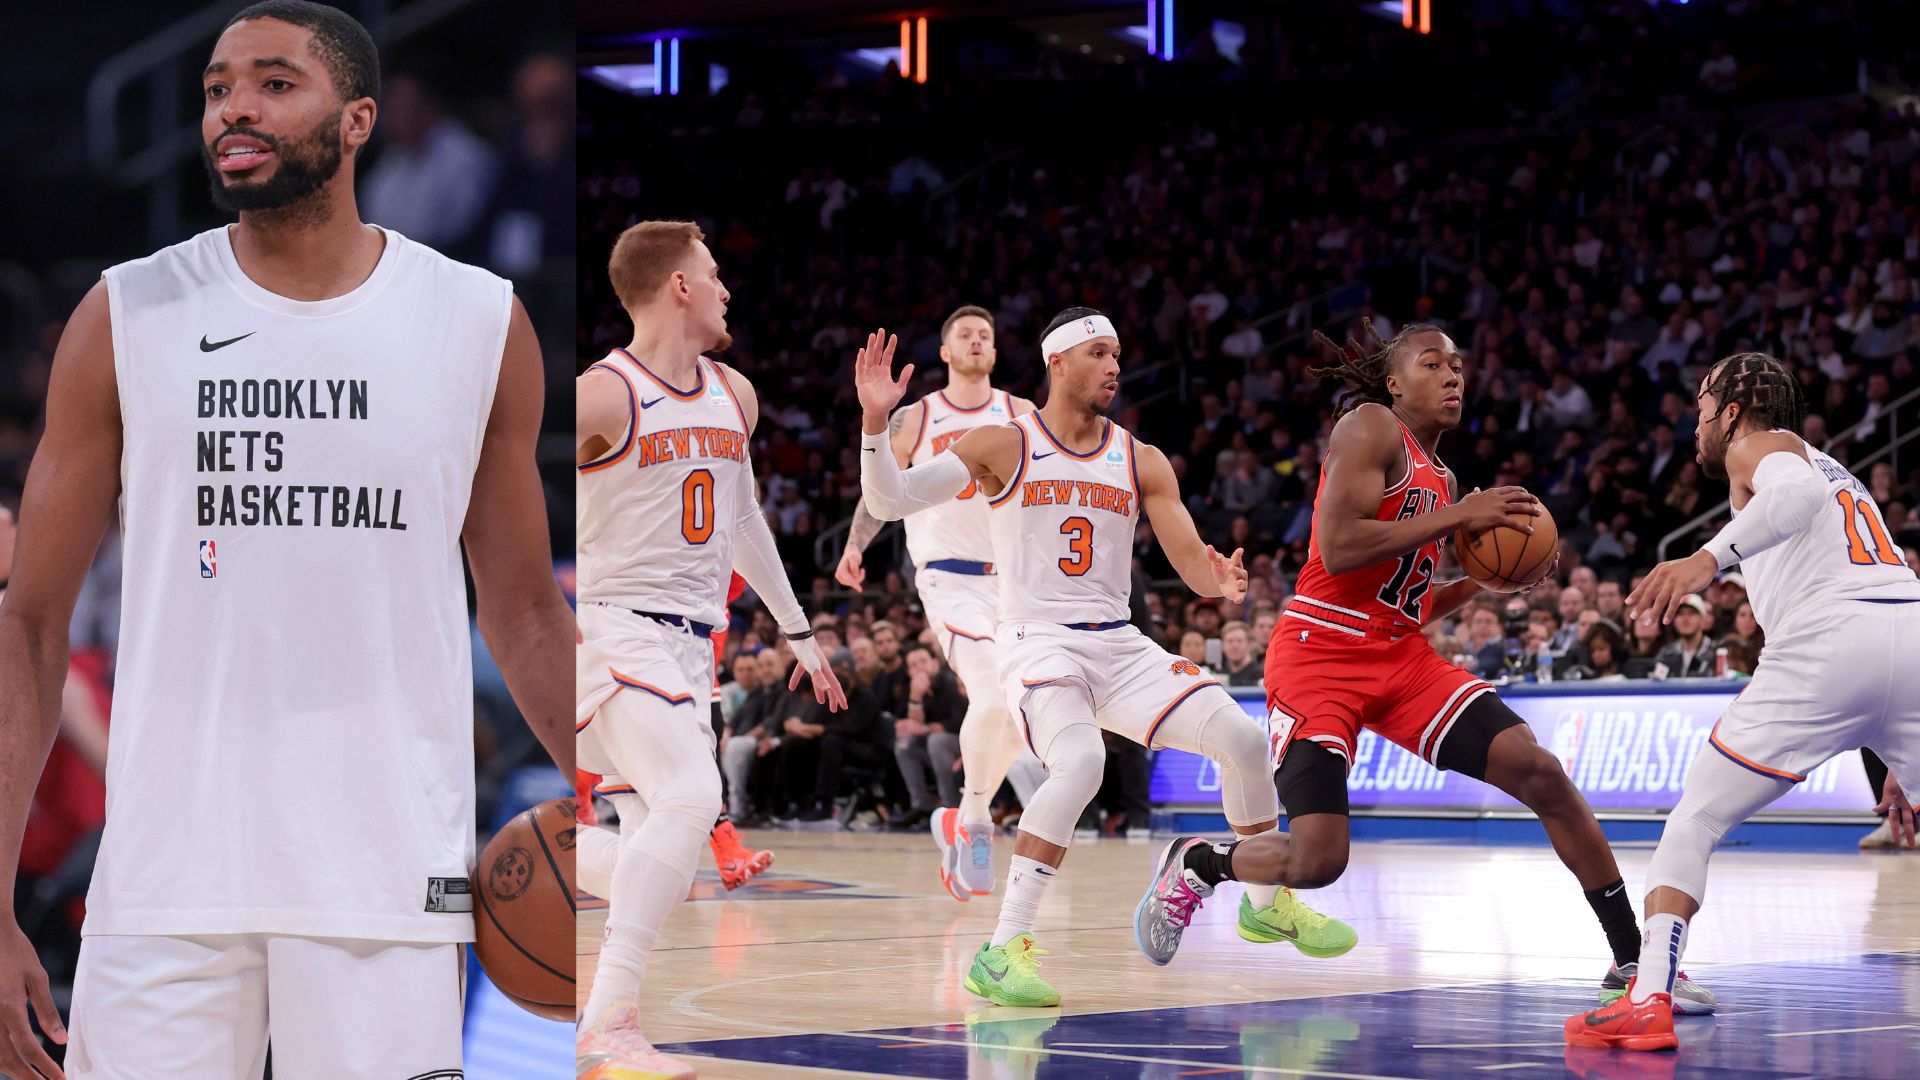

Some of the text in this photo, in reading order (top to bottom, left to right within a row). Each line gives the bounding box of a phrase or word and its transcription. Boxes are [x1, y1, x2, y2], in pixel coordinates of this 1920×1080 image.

[197, 378, 368, 419] BROOKLYN
[197, 430, 284, 472] NETS
[638, 426, 746, 469] NEW YORK
[197, 484, 407, 530] BASKETBALL
[681, 468, 715, 545] 0
[1022, 479, 1133, 517] NEW YORK
[1058, 516, 1094, 576] 3
[1835, 488, 1906, 567] 11
[1376, 548, 1434, 625] 12
